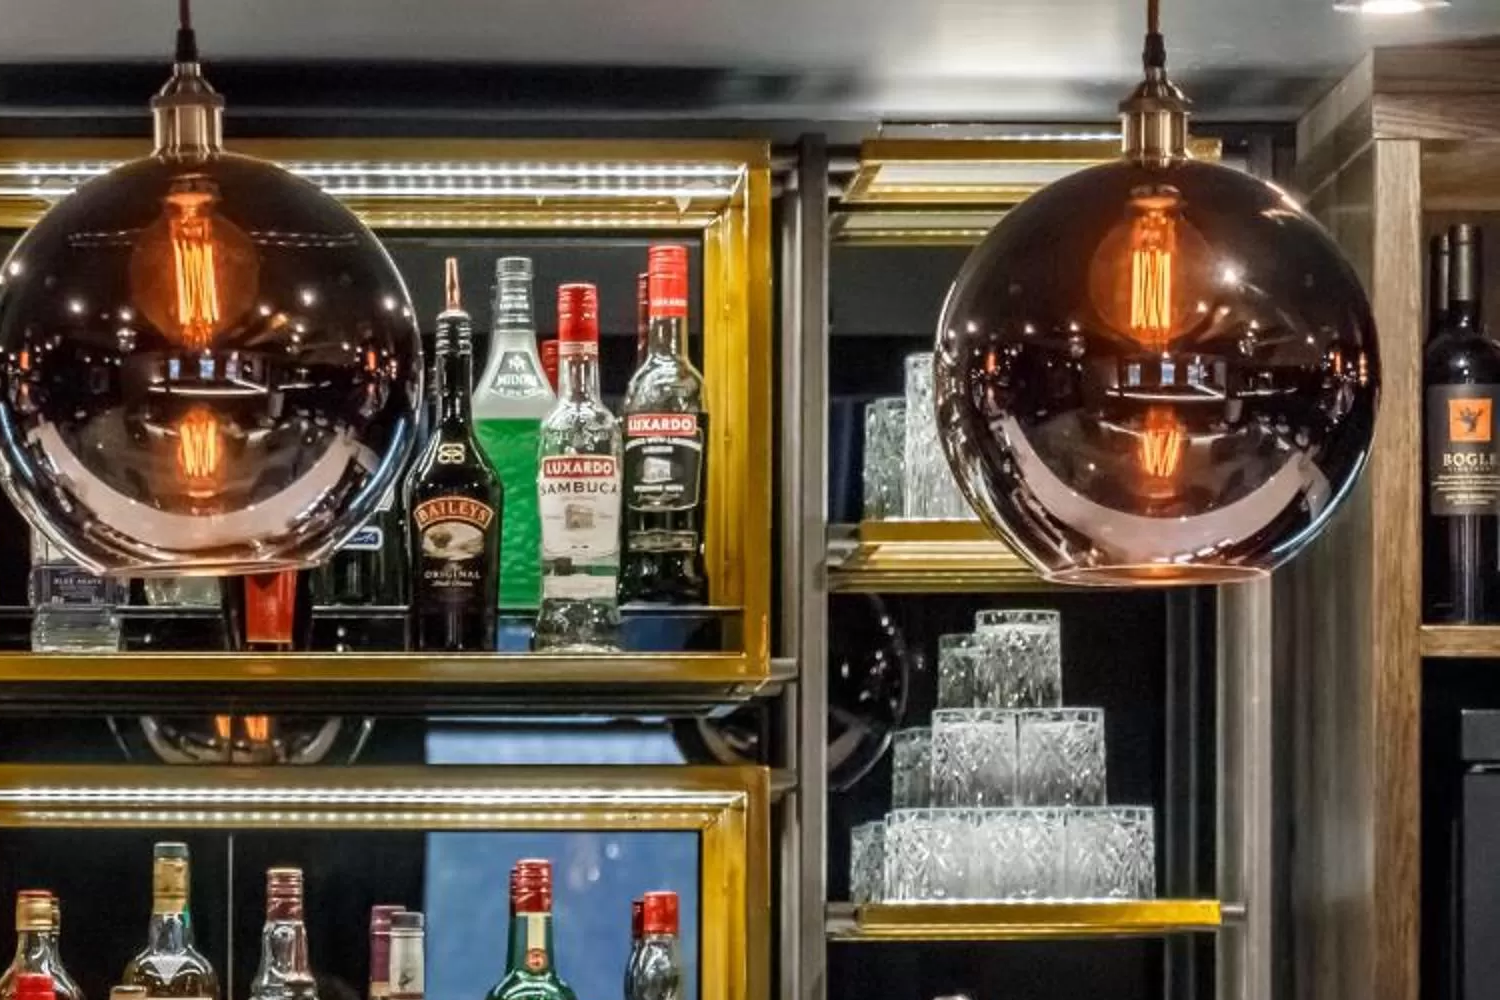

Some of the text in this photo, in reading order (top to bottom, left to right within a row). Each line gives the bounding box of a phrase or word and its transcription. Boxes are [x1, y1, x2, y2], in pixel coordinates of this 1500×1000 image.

[628, 419, 693, 431] LUXARDO
[544, 460, 613, 475] LUXARDO
[418, 501, 487, 522] BAILEYS
